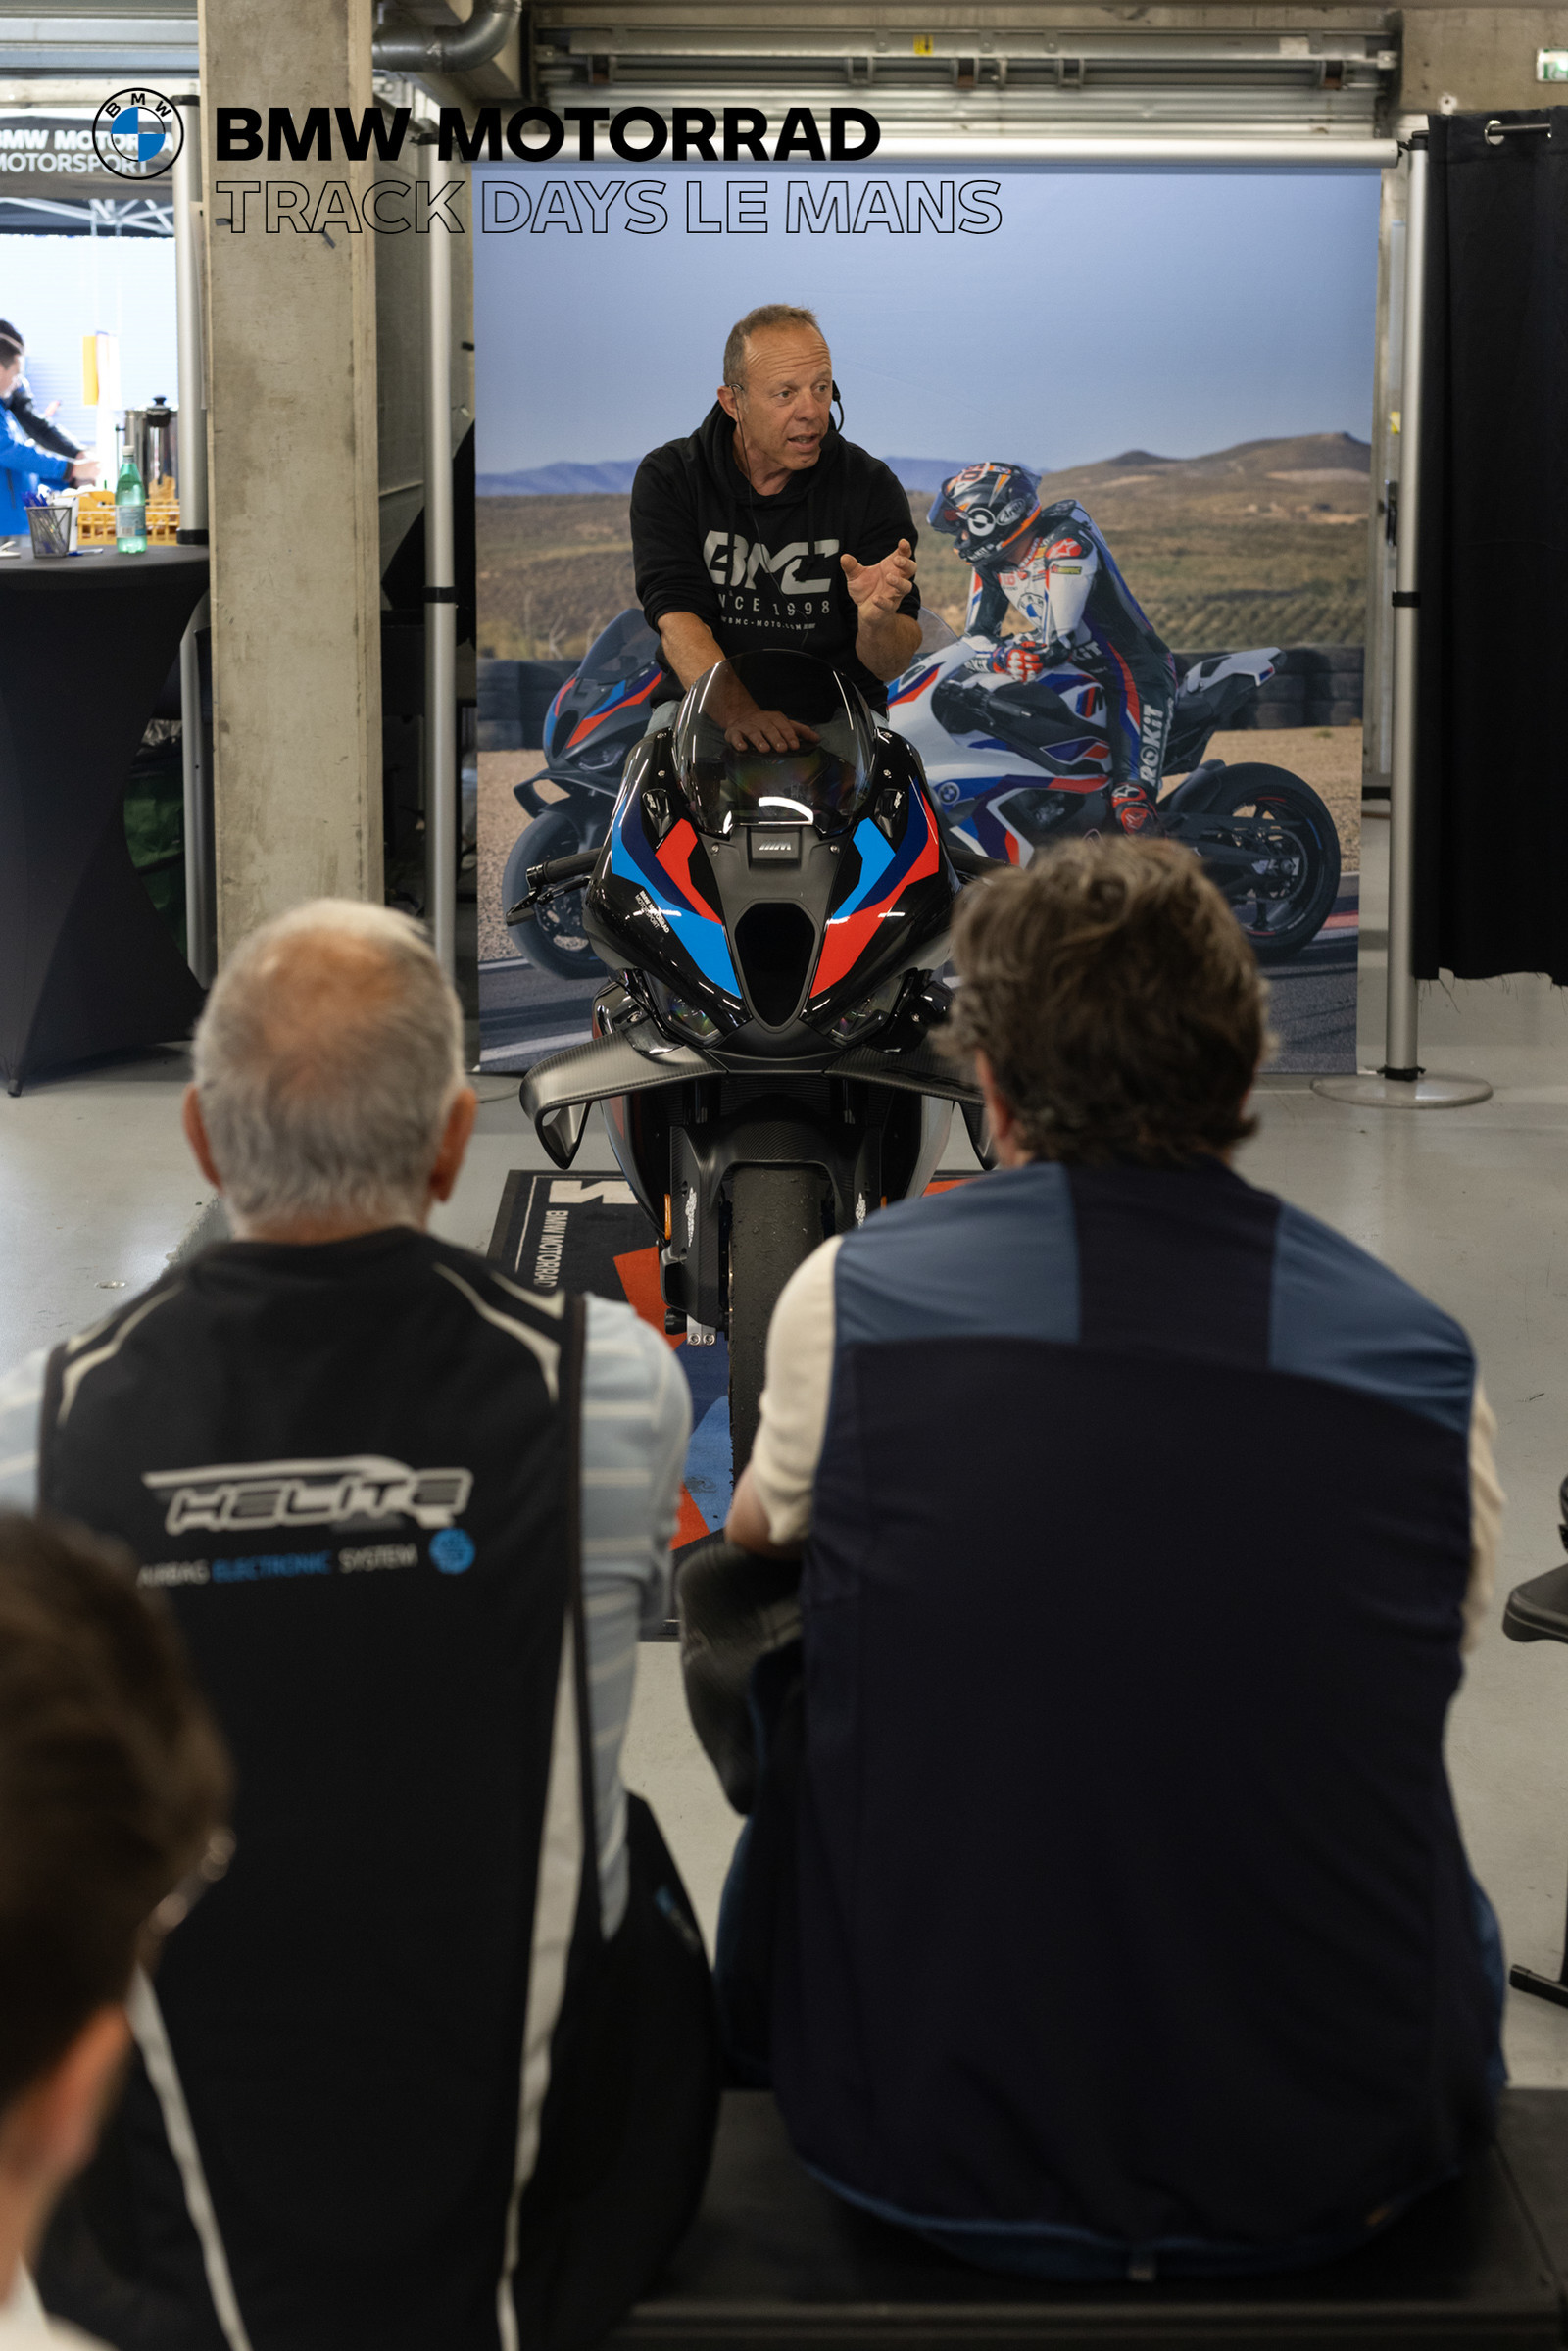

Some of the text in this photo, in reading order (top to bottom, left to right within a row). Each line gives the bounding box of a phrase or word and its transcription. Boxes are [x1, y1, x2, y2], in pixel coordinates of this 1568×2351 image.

[0, 129, 49, 150] MW
[703, 530, 840, 595] BMC
[772, 599, 831, 616] 1998
[533, 1210, 569, 1288] BMW MOTORRAD
[163, 1466, 474, 1536] HELITE
[212, 1550, 332, 1583] ELECTRONIC
[338, 1543, 418, 1574] SYSTEM
